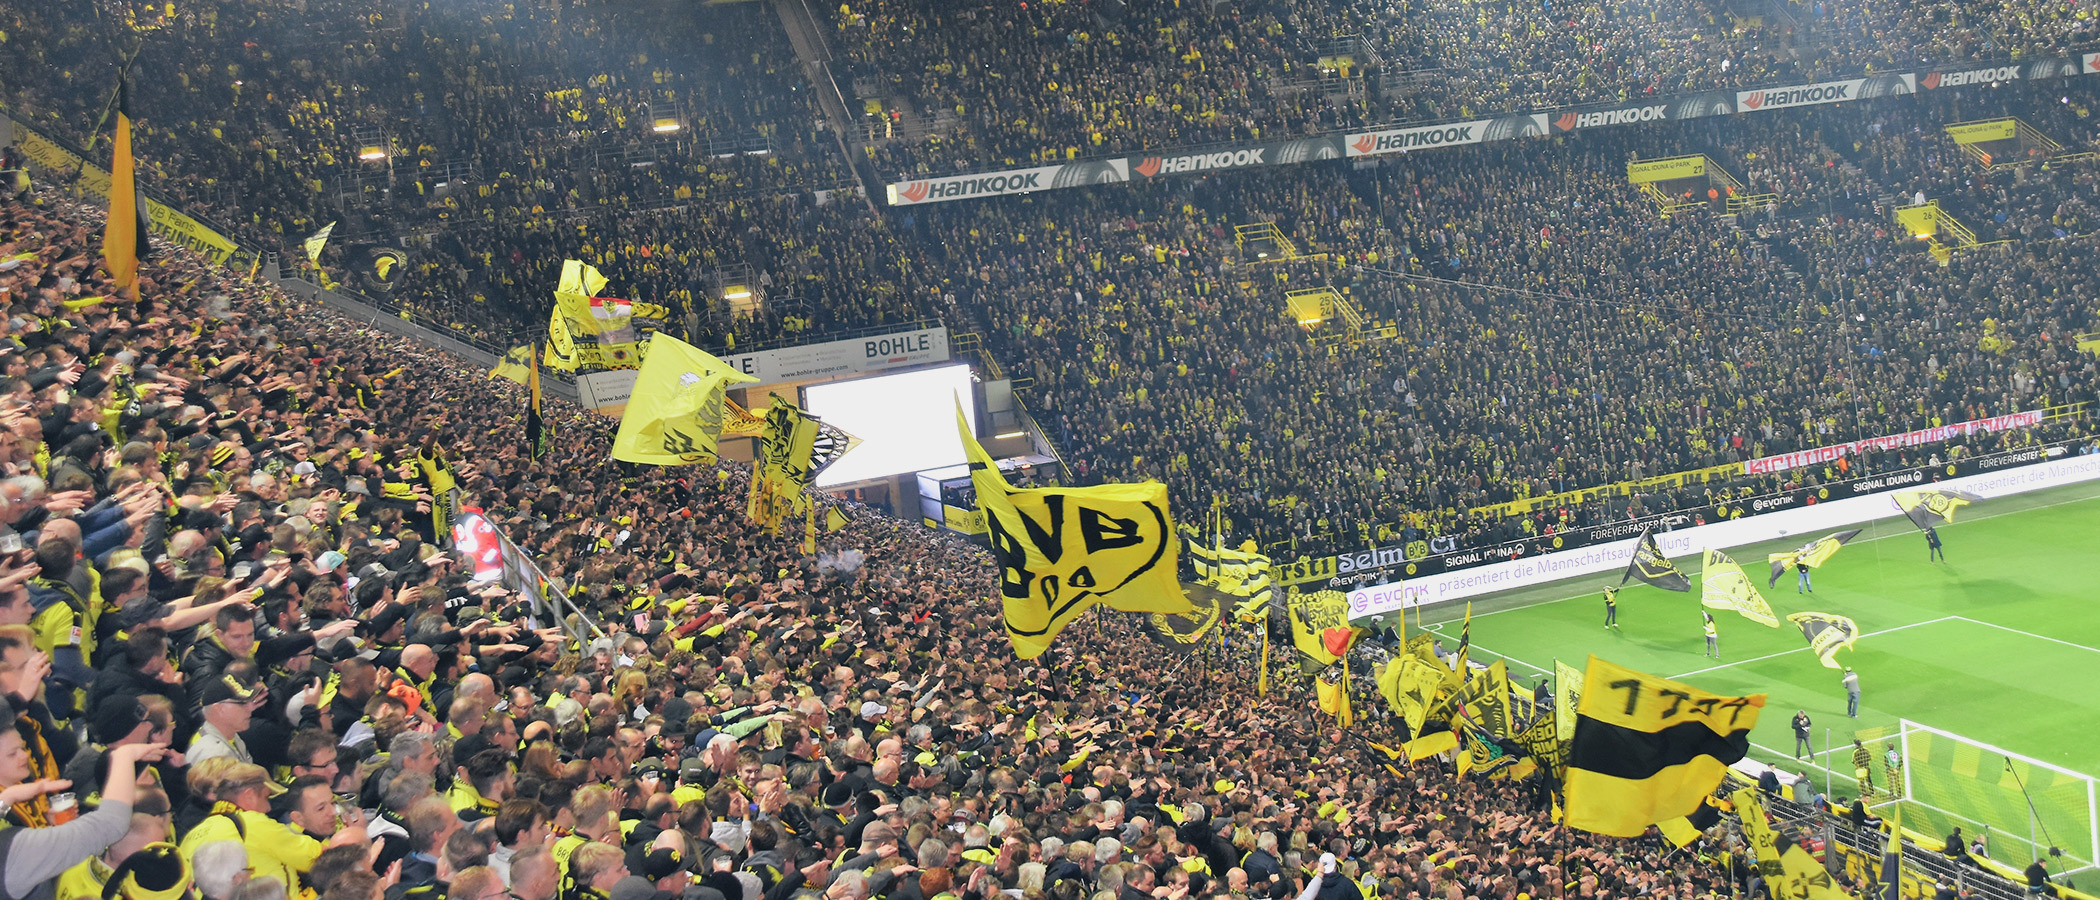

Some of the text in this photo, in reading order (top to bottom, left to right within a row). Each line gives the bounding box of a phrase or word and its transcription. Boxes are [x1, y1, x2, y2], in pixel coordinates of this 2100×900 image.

[2005, 129, 2013, 137] 27
[1693, 166, 1703, 174] 27
[167, 212, 196, 232] Fans
[1923, 211, 1932, 220] 26
[1320, 296, 1331, 306] 25
[1320, 307, 1331, 316] 24
[865, 334, 930, 358] BOHLE
[781, 364, 848, 378] www.bohle-gruppe.com
[1853, 474, 1912, 492] SIGNAL IDUNA
[1966, 474, 2025, 493] präsentiert
[2029, 469, 2045, 481] die
[1762, 496, 1794, 508] EVONIK
[986, 494, 1144, 598] BVB
[1338, 548, 1404, 573] Selm
[1439, 569, 1509, 594] präsentiert
[1514, 564, 1534, 578] die
[1537, 536, 1690, 575] Mannschaftsaufllung
[1446, 547, 1513, 567] SIGNAL INA
